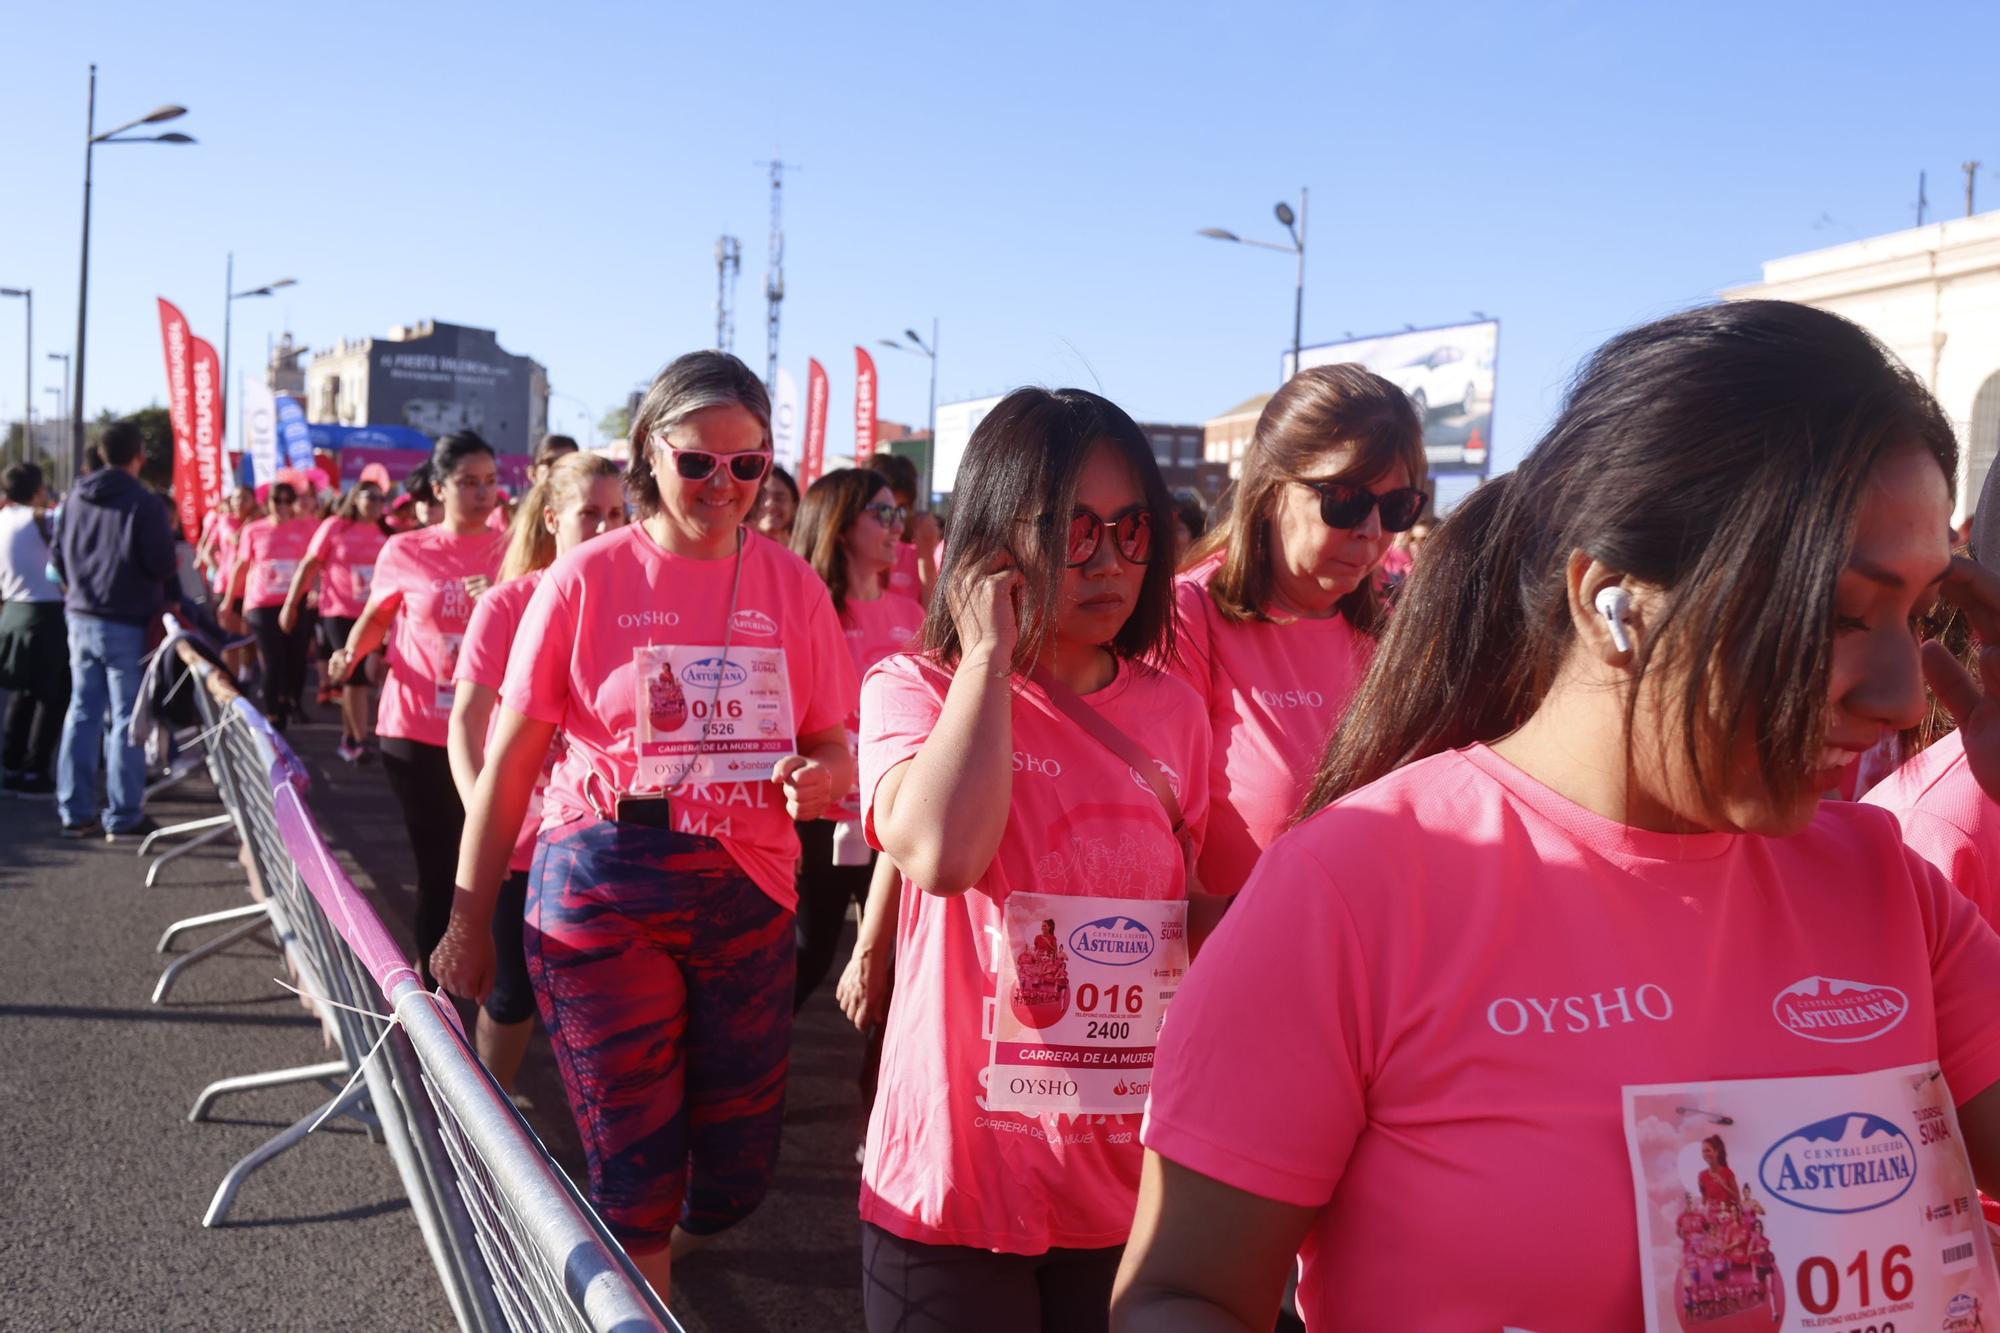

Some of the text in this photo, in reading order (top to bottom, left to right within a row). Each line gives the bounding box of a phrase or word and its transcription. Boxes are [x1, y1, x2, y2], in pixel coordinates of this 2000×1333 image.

[617, 611, 680, 628] OYSHO
[1262, 689, 1324, 709] OYSHO
[692, 700, 743, 719] 016
[702, 723, 735, 736] 6526
[658, 743, 699, 753] CARRERA
[702, 743, 715, 751] DE
[717, 743, 729, 751] LA
[730, 742, 759, 751] MUJER
[1012, 751, 1062, 777] SHO
[1076, 932, 1149, 953] ASTURIANA
[1160, 928, 1183, 940] SUMA
[1076, 982, 1144, 1013] 016
[1487, 983, 1674, 1036] OYSHO
[1784, 998, 1902, 1029] ASTURIANA
[1086, 1021, 1130, 1040] 2400
[1019, 1049, 1154, 1064] CARRERA DE LA MUJER
[1010, 1078, 1078, 1096] OYSHO
[974, 1116, 1028, 1135] CARRERA
[1030, 1127, 1045, 1140] DE
[1919, 1119, 1952, 1146] SUMA
[1804, 1147, 1862, 1160] CENTRAL
[1776, 1153, 1910, 1190] ASTURIANA
[1796, 1244, 1914, 1315] 016
